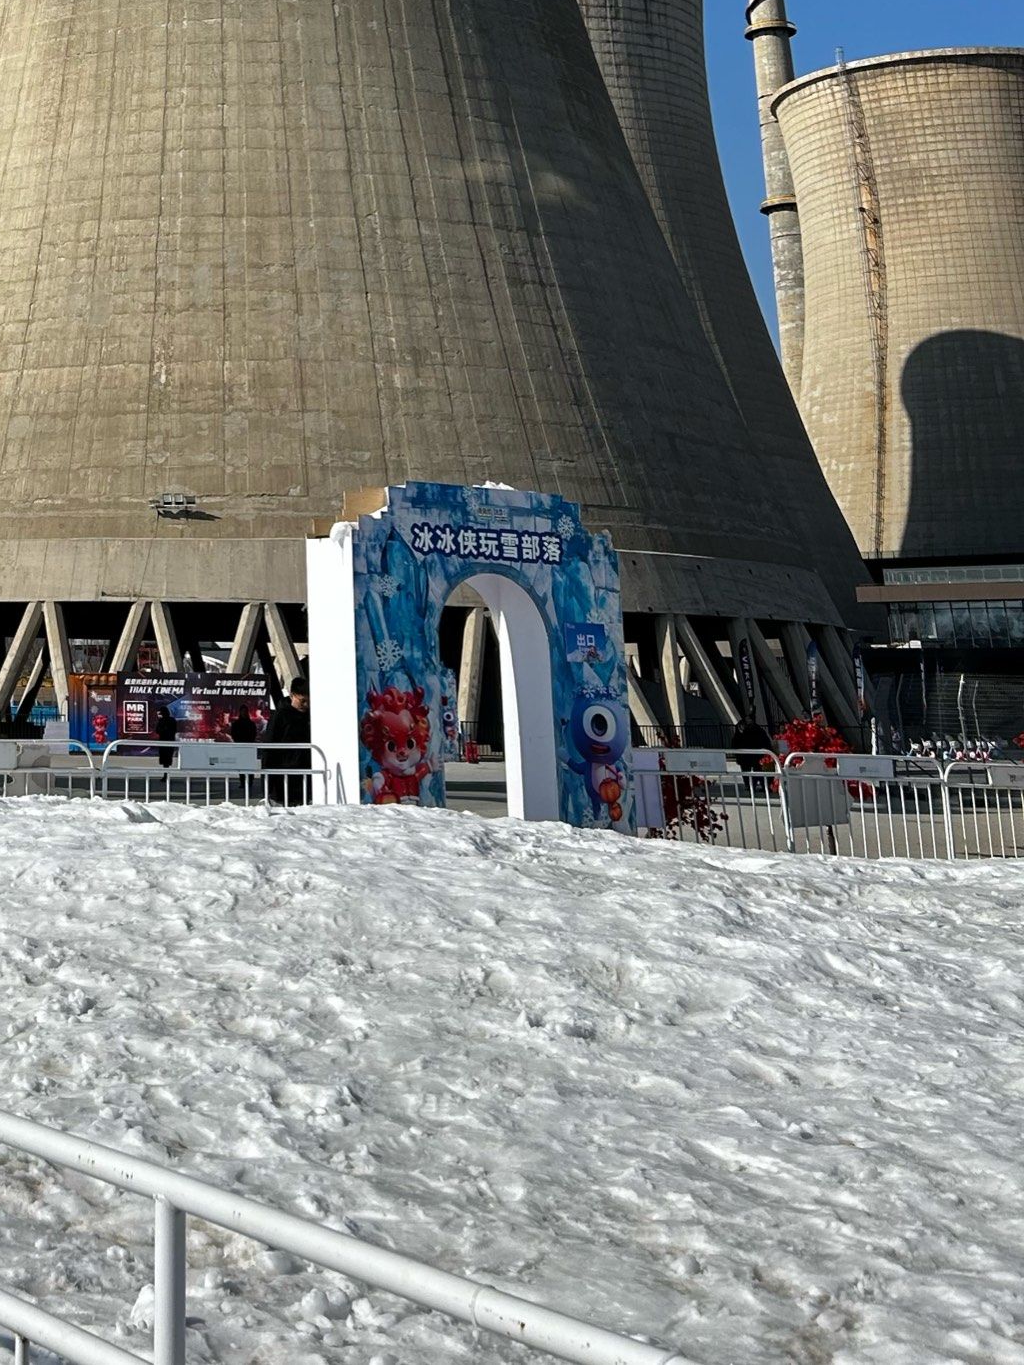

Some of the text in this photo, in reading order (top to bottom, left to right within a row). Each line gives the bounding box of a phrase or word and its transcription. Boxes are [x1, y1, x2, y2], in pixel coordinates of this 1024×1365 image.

[413, 526, 561, 562] 冰冰侠玩雪部落
[576, 633, 595, 646] 出口
[155, 687, 184, 695] CINEMA
[191, 687, 221, 695] Virtual
[126, 703, 145, 712] MR
